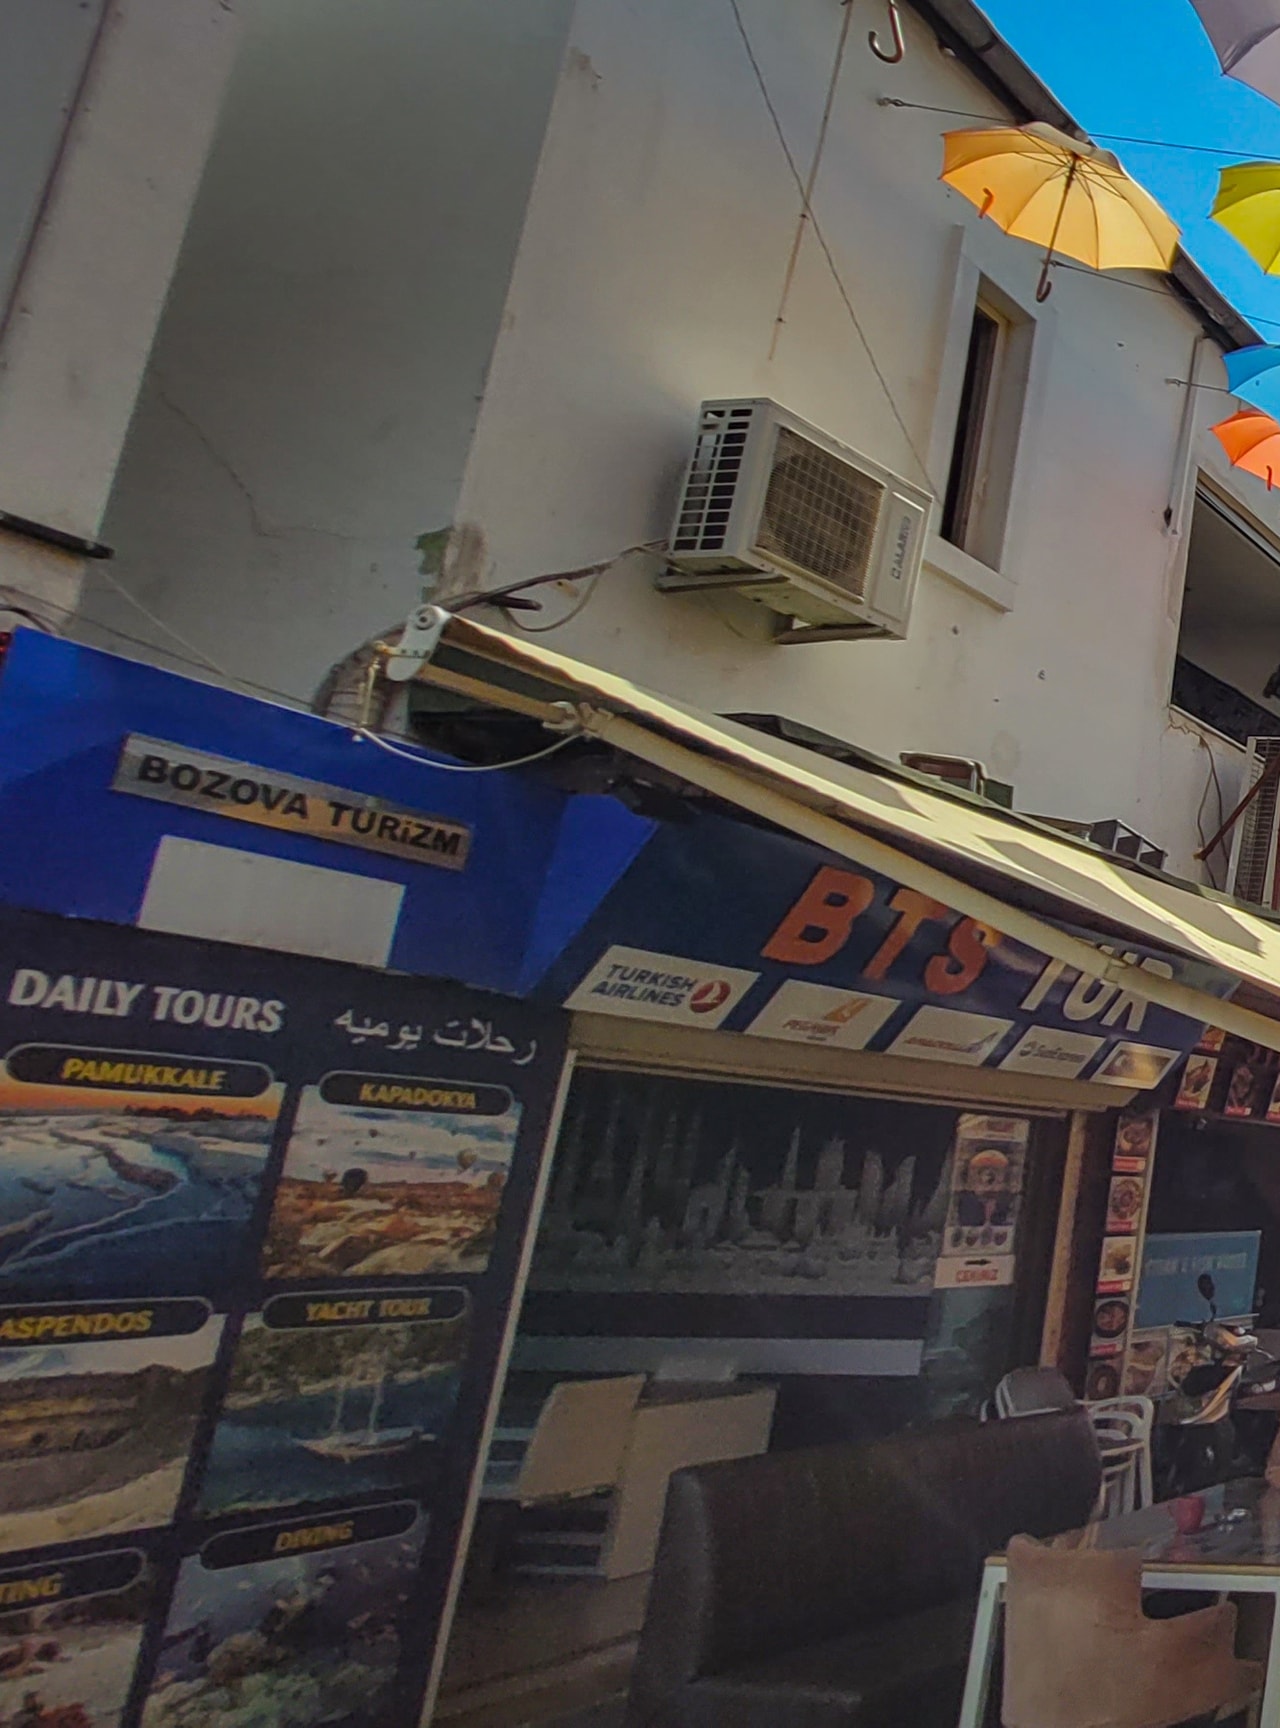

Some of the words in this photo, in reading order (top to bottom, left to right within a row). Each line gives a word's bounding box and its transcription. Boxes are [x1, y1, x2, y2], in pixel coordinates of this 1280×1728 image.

[137, 754, 309, 820] BOZOVA
[761, 865, 999, 995] BTS
[606, 963, 699, 991] TURKISH
[9, 968, 145, 1018] DAILY
[154, 984, 287, 1034] TOURS
[591, 981, 686, 1008] AIRLINES
[432, 1014, 537, 1065] رحلات
[63, 1056, 227, 1092] PAMUKKALE
[359, 1081, 477, 1111] KAPADOKYA
[0, 1309, 153, 1340] ASPENDOS
[306, 1300, 371, 1322] YACHT
[274, 1520, 354, 1553] DIVING
